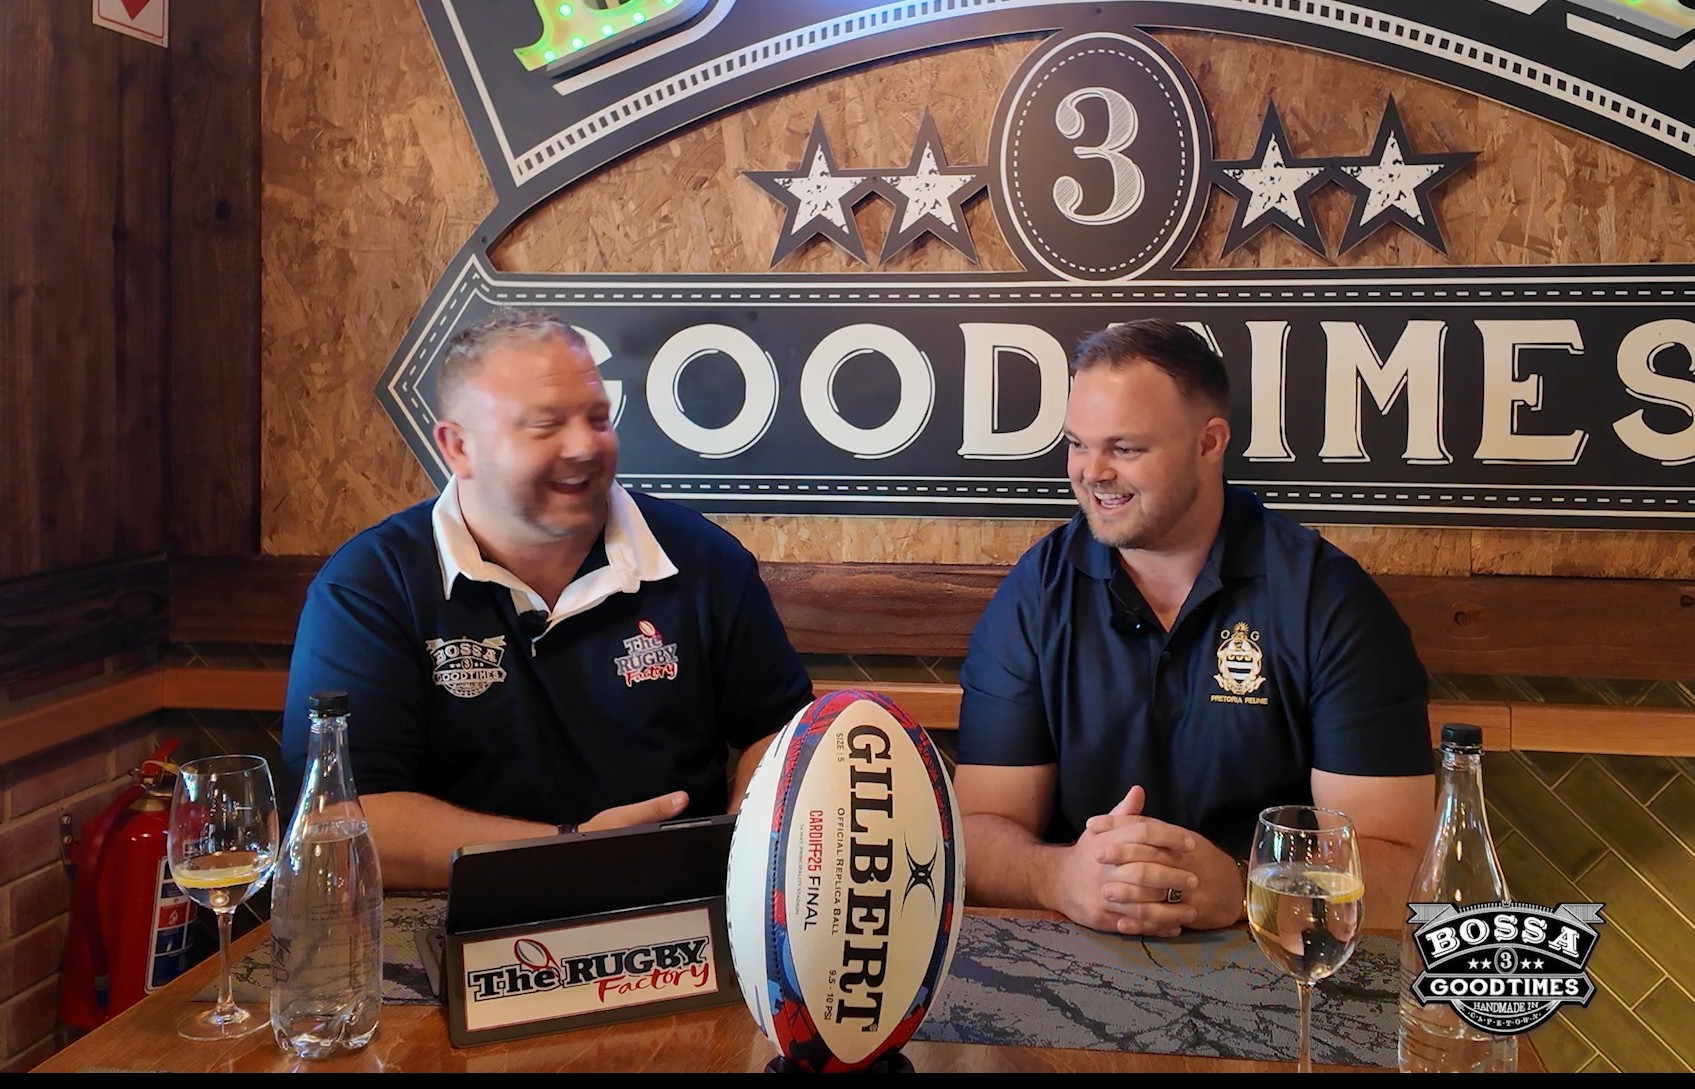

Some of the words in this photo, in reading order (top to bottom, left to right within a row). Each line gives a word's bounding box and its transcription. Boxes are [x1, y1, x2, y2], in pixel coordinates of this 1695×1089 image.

[1053, 87, 1146, 225] 3
[571, 319, 1695, 466] OODIMES
[433, 642, 498, 665] BOSSA
[624, 634, 663, 654] The
[615, 644, 678, 674] RUGBY
[436, 670, 500, 682] GOODTIMES
[623, 662, 678, 688] Factory
[1210, 694, 1243, 704] PRETORIA
[836, 732, 845, 750] SIZE
[808, 810, 823, 872] CARDIFF25
[837, 807, 845, 855] OFFICIAL
[834, 858, 844, 904] REPLICA
[836, 725, 893, 1032] GILBERT
[804, 875, 821, 931] FINAL
[831, 908, 841, 936] BALL
[471, 965, 562, 1000] The
[564, 938, 708, 985] RUGBY
[593, 962, 709, 1003] Factory
[828, 969, 837, 984] 9.5
[824, 1005, 833, 1020] PSI
[826, 993, 834, 1003] 10
